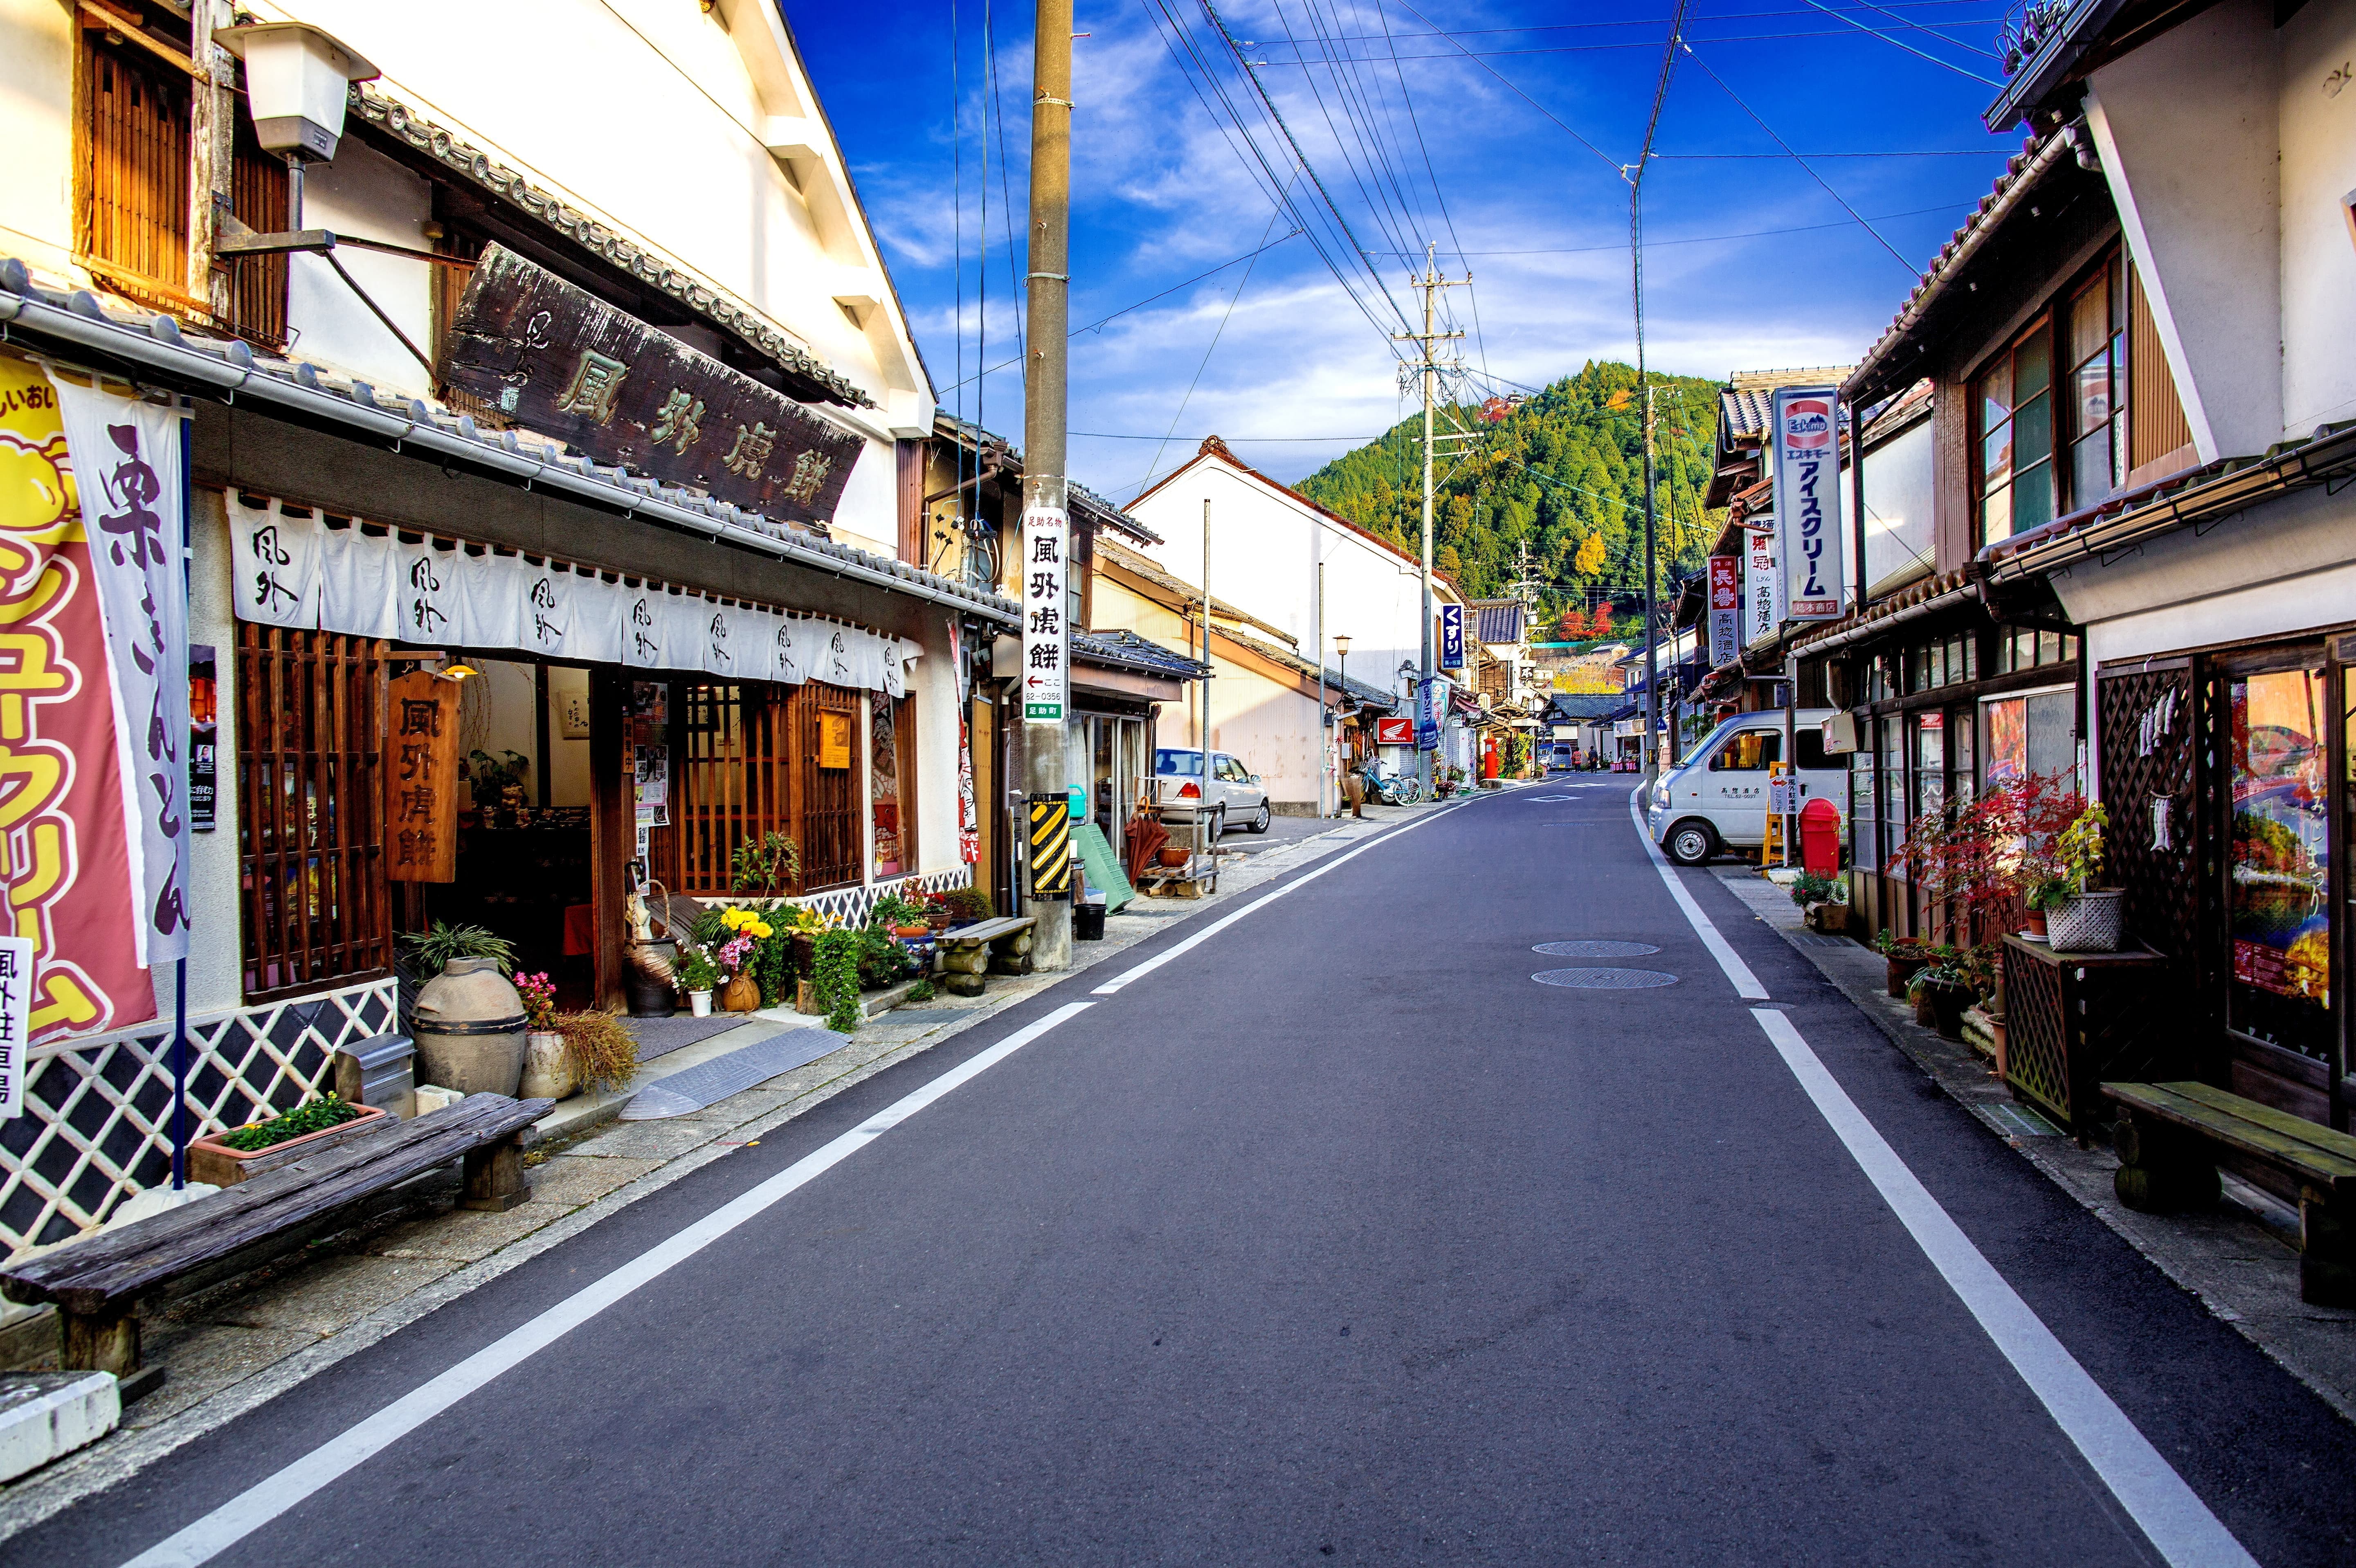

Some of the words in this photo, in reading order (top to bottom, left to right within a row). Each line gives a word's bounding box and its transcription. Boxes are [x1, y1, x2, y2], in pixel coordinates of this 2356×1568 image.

[1788, 418, 1827, 432] Eskimo
[1787, 449, 1830, 460] エスキモー
[1027, 516, 1062, 528] 足助名物
[1798, 462, 1825, 596] アイスクリーム
[252, 525, 299, 613] 風外
[410, 556, 447, 633] 風外
[530, 577, 562, 645] 風外
[1029, 536, 1059, 670] 風外虎餅
[632, 598, 658, 660] 風外
[710, 613, 731, 670] 風外
[777, 624, 794, 675] 風外
[1446, 608, 1460, 654] くすり
[831, 631, 848, 679] 風外
[884, 647, 898, 692] 風外
[1026, 692, 1061, 701] 62-0356
[1029, 706, 1057, 714] 足助町
